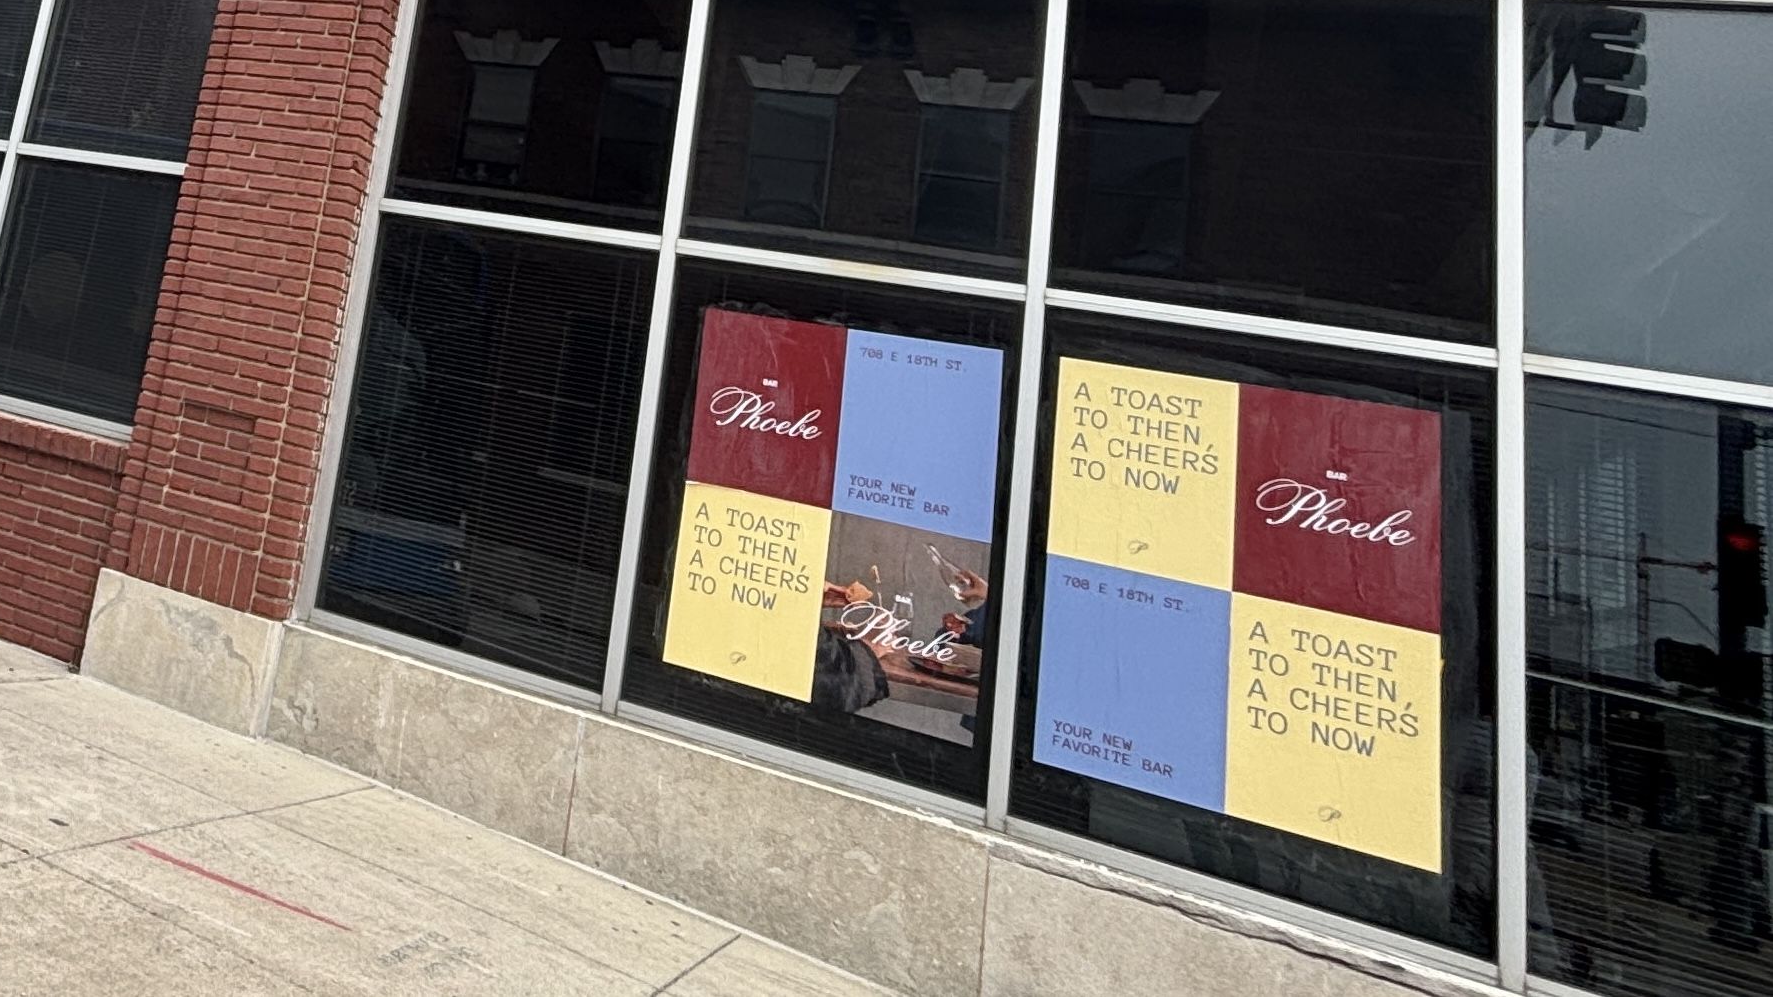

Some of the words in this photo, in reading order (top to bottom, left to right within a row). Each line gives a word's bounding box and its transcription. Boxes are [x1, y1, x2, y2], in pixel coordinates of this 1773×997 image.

[860, 348, 883, 360] 708
[891, 352, 898, 362] E
[907, 354, 938, 368] 18TH
[763, 378, 778, 388] BAR
[1073, 382, 1091, 402] A
[1111, 386, 1202, 419] TOAST
[710, 386, 823, 439] Phoebe
[1074, 406, 1108, 429] TO
[1128, 414, 1214, 452] THEN,
[1071, 432, 1088, 452] A
[1107, 438, 1219, 475] CHEERS
[849, 474, 883, 491] YOUR
[891, 482, 917, 497] NEW
[1071, 457, 1106, 481] TO
[1124, 467, 1180, 494] NOW
[1326, 470, 1347, 481] BAR
[695, 502, 709, 521] A
[726, 508, 800, 541] TOAST
[848, 488, 915, 510] FAVORITE
[923, 502, 950, 516] BAR
[1256, 478, 1415, 546] Phoebe
[694, 525, 722, 547] TO
[738, 535, 806, 574] THEN,
[688, 572, 716, 595] TO
[731, 583, 777, 610] NOW
[690, 549, 703, 568] A
[719, 556, 809, 594] CHEERS
[1062, 575, 1090, 590] 708
[1098, 583, 1107, 594] E
[1117, 587, 1154, 604] 18TH
[841, 601, 957, 661] Phoebe
[1248, 621, 1268, 644] A
[1291, 629, 1397, 672] TOAST
[1248, 648, 1289, 676] TO
[1312, 662, 1412, 711] THEN,
[1247, 678, 1268, 702] A
[1289, 687, 1419, 737] CHEERS
[1053, 719, 1093, 741] YOUR
[1102, 732, 1133, 751] NEW
[1247, 706, 1288, 735] TO
[1311, 721, 1375, 757] NOW
[1052, 734, 1132, 767] FAVORITE
[1142, 758, 1174, 778] BAR
